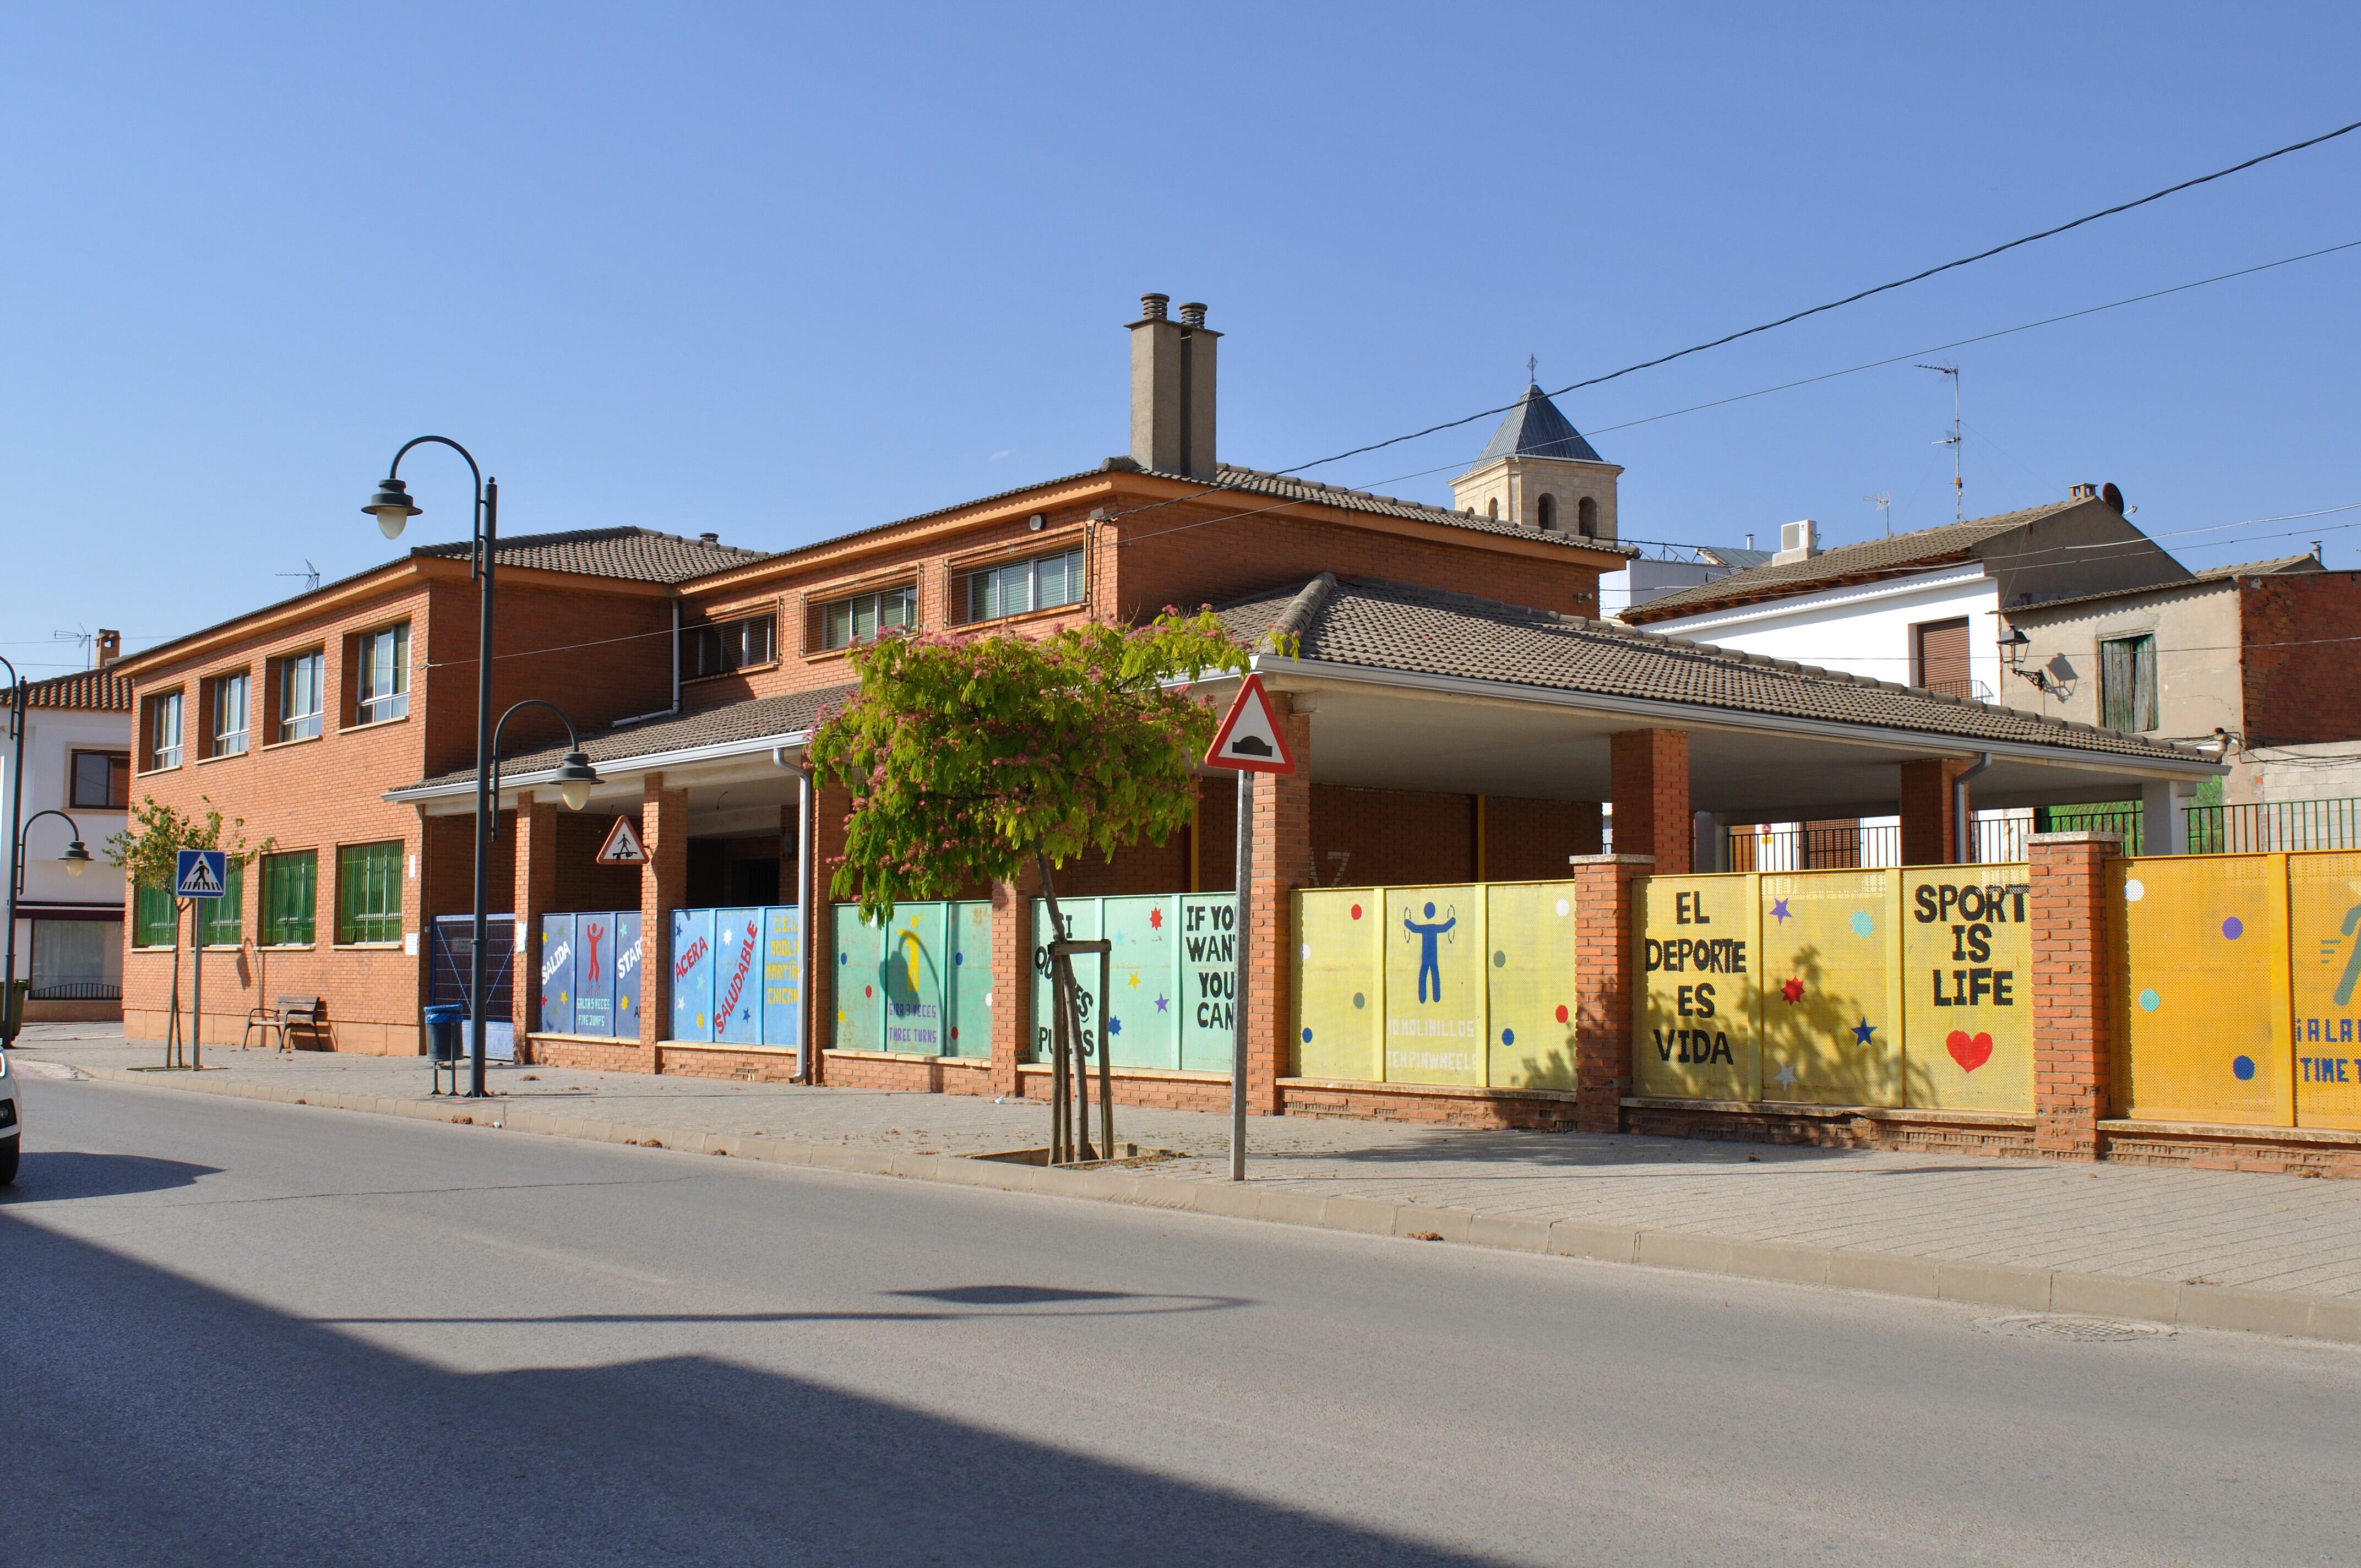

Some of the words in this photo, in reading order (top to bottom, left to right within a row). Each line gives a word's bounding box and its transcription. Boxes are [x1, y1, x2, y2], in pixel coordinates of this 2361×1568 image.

[1187, 906, 1205, 931] IF
[1211, 905, 1236, 931] YO
[1676, 891, 1710, 924] EL
[1914, 883, 2030, 923] SPORT
[618, 937, 643, 979] STAR
[675, 936, 709, 983] ACERA
[1186, 934, 1235, 962] WAN
[1645, 938, 1747, 973] DEPORTE
[1951, 923, 1993, 963] IS
[541, 940, 571, 985] SALIDA
[715, 920, 758, 1035] SALUDABLE
[1198, 971, 1234, 1000] YOU
[1678, 983, 1716, 1019] ES
[1933, 967, 2013, 1006] LIFE
[578, 1015, 589, 1025] FIVE
[589, 1015, 605, 1027] JUMPS
[889, 1003, 904, 1016] GIRA
[906, 1004, 911, 1016] 3
[913, 1004, 937, 1018] VECES
[1197, 1002, 1234, 1031] CAN
[889, 1027, 911, 1042] THREE
[914, 1028, 937, 1043] TURNS
[1401, 1019, 1475, 1037] MOLINILLOS
[1386, 1050, 1406, 1067] TEN
[1653, 1028, 1734, 1065] VIDA
[2299, 1057, 2349, 1083] TIME
